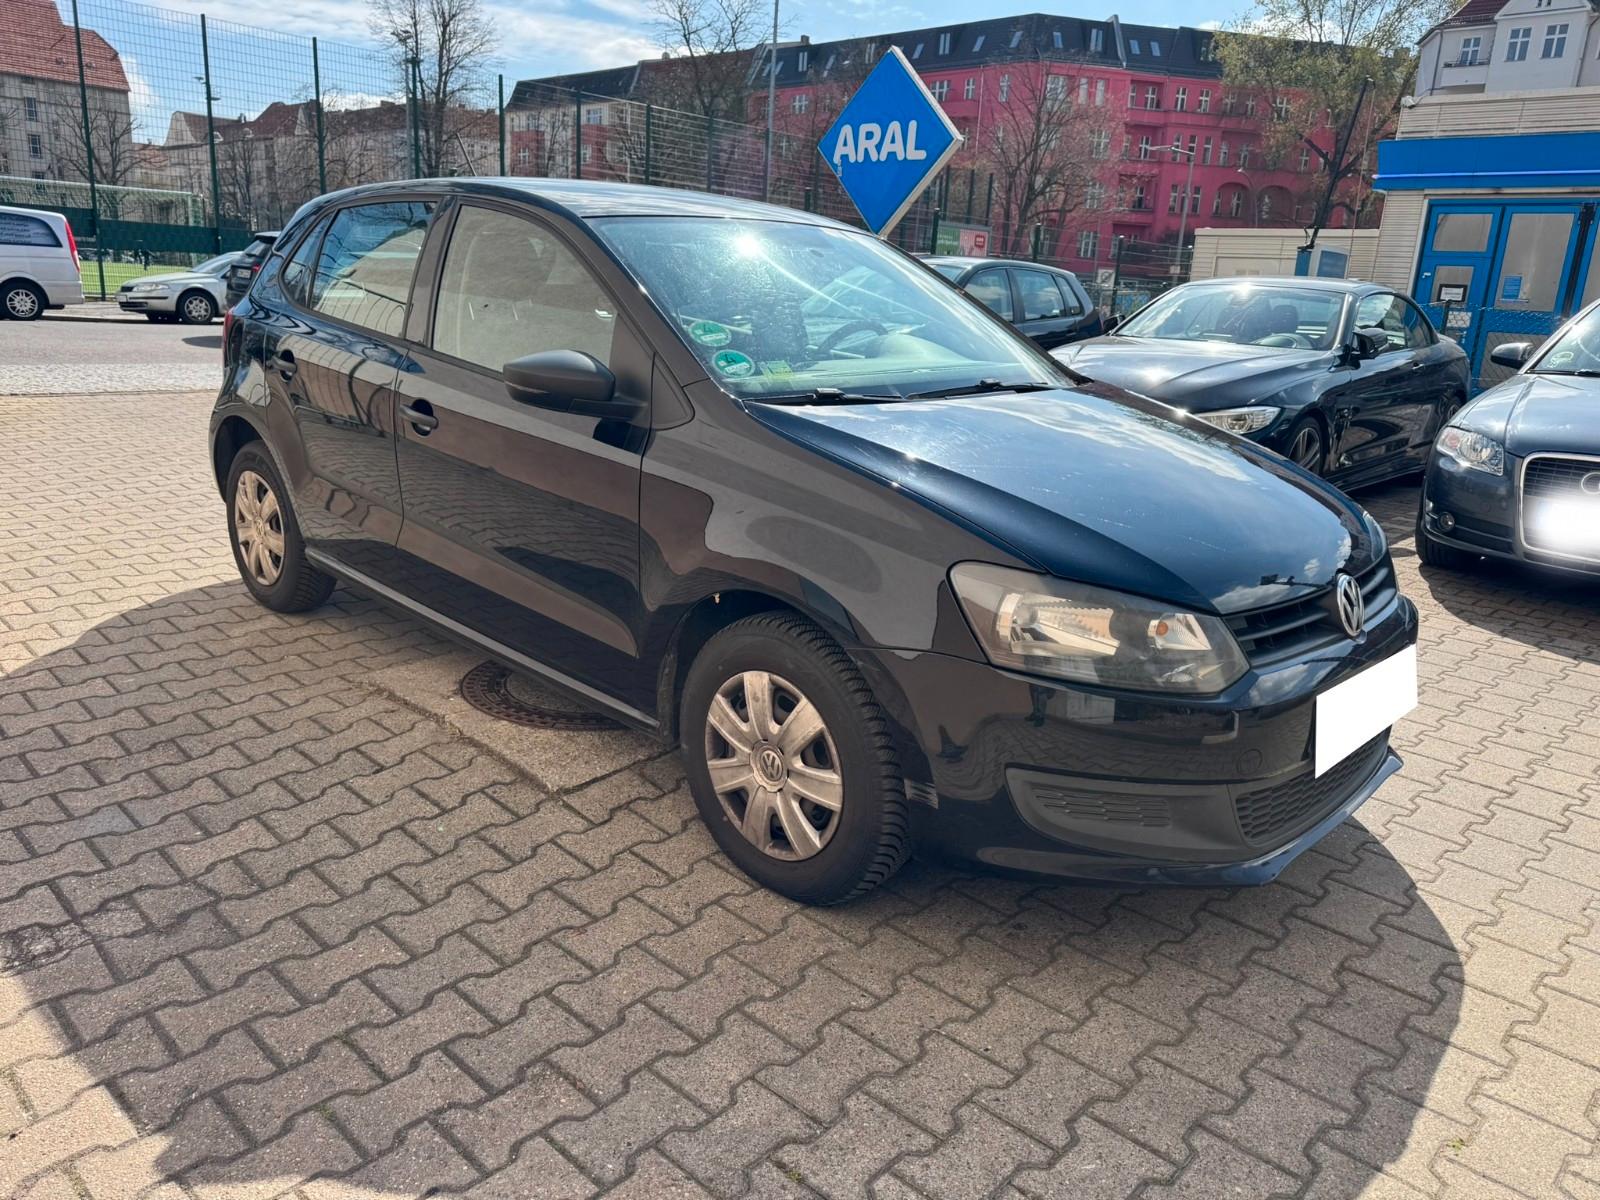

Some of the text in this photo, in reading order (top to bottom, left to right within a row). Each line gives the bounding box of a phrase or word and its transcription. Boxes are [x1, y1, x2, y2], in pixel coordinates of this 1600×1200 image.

[832, 119, 927, 164] ARAL
[1337, 573, 1364, 636] VW
[760, 749, 783, 781] VW
